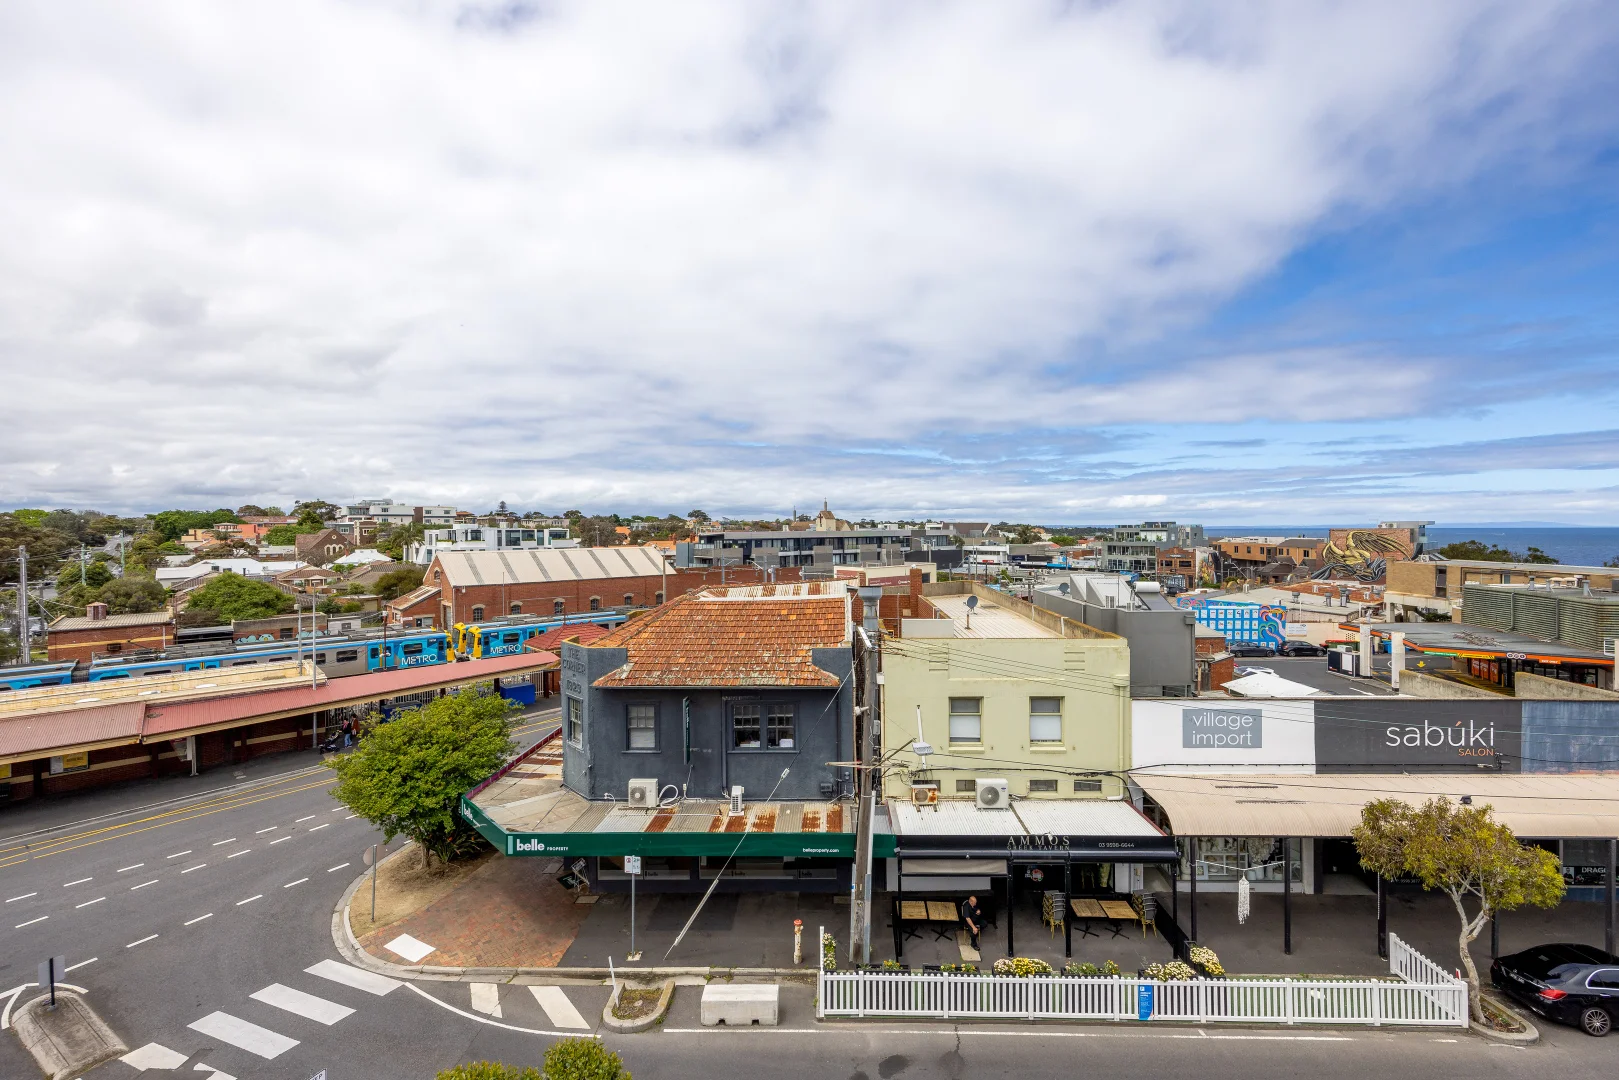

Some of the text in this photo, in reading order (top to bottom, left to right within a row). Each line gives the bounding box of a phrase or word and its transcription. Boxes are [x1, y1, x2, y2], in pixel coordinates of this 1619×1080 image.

[489, 643, 521, 655] METRO
[401, 653, 438, 666] METRO
[1192, 712, 1253, 730] village
[1192, 730, 1253, 748] import
[1385, 719, 1495, 747] sabúki
[1458, 748, 1494, 757] SALON
[516, 838, 545, 851] belle
[1007, 835, 1070, 846] AMMOS
